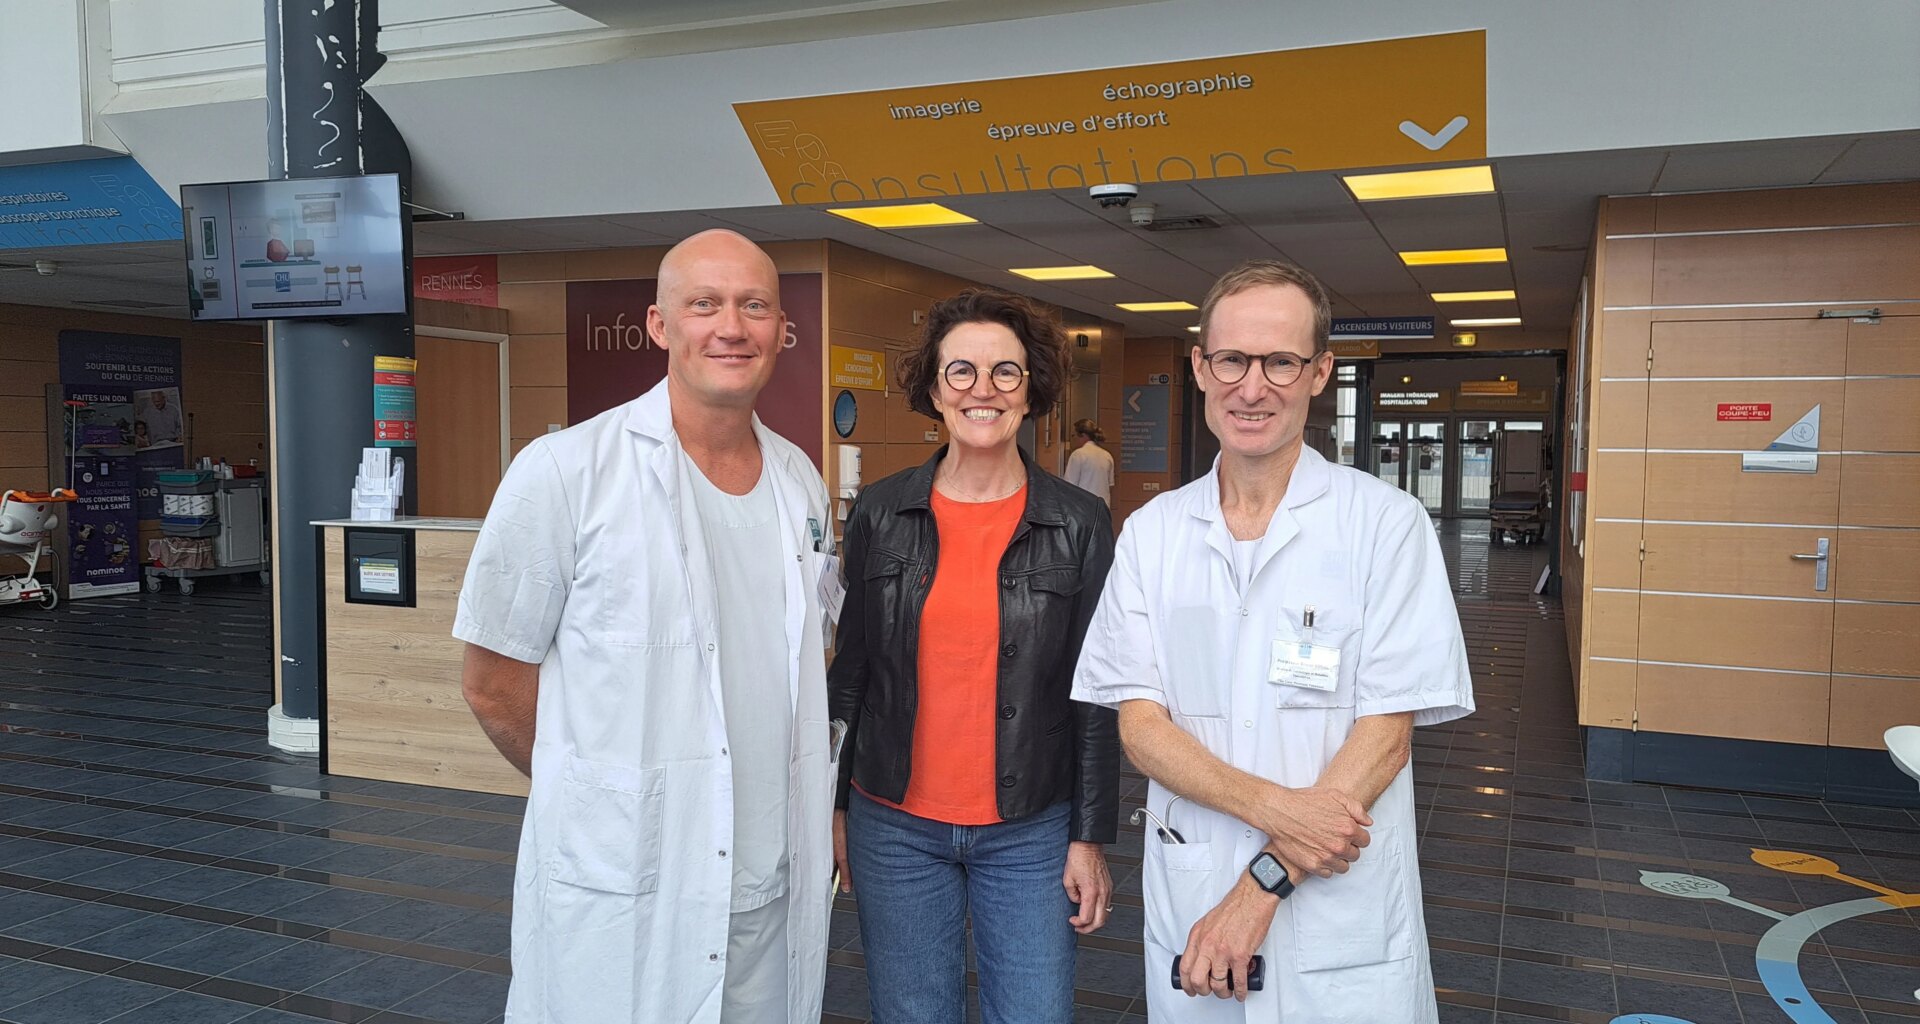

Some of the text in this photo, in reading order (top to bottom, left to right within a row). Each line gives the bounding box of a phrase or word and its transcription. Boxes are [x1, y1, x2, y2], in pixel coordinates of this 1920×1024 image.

[1103, 72, 1252, 100] échographie
[888, 97, 981, 120] imagerie
[987, 110, 1168, 141] épreuve d'effort
[49, 206, 121, 222] bronchique
[421, 274, 483, 291] RENNES
[1334, 320, 1432, 332] ASCENSEURS VISITEURS
[85, 362, 174, 374] SOUTENIR LES ACTIONS
[101, 372, 112, 380] DU
[114, 373, 132, 381] CHU
[144, 374, 174, 383] RENNES
[72, 393, 127, 402] FAITES UN DON
[94, 495, 131, 503] CONCERNÉS
[111, 502, 131, 510] SANTÉ
[86, 566, 125, 577] nominoe
